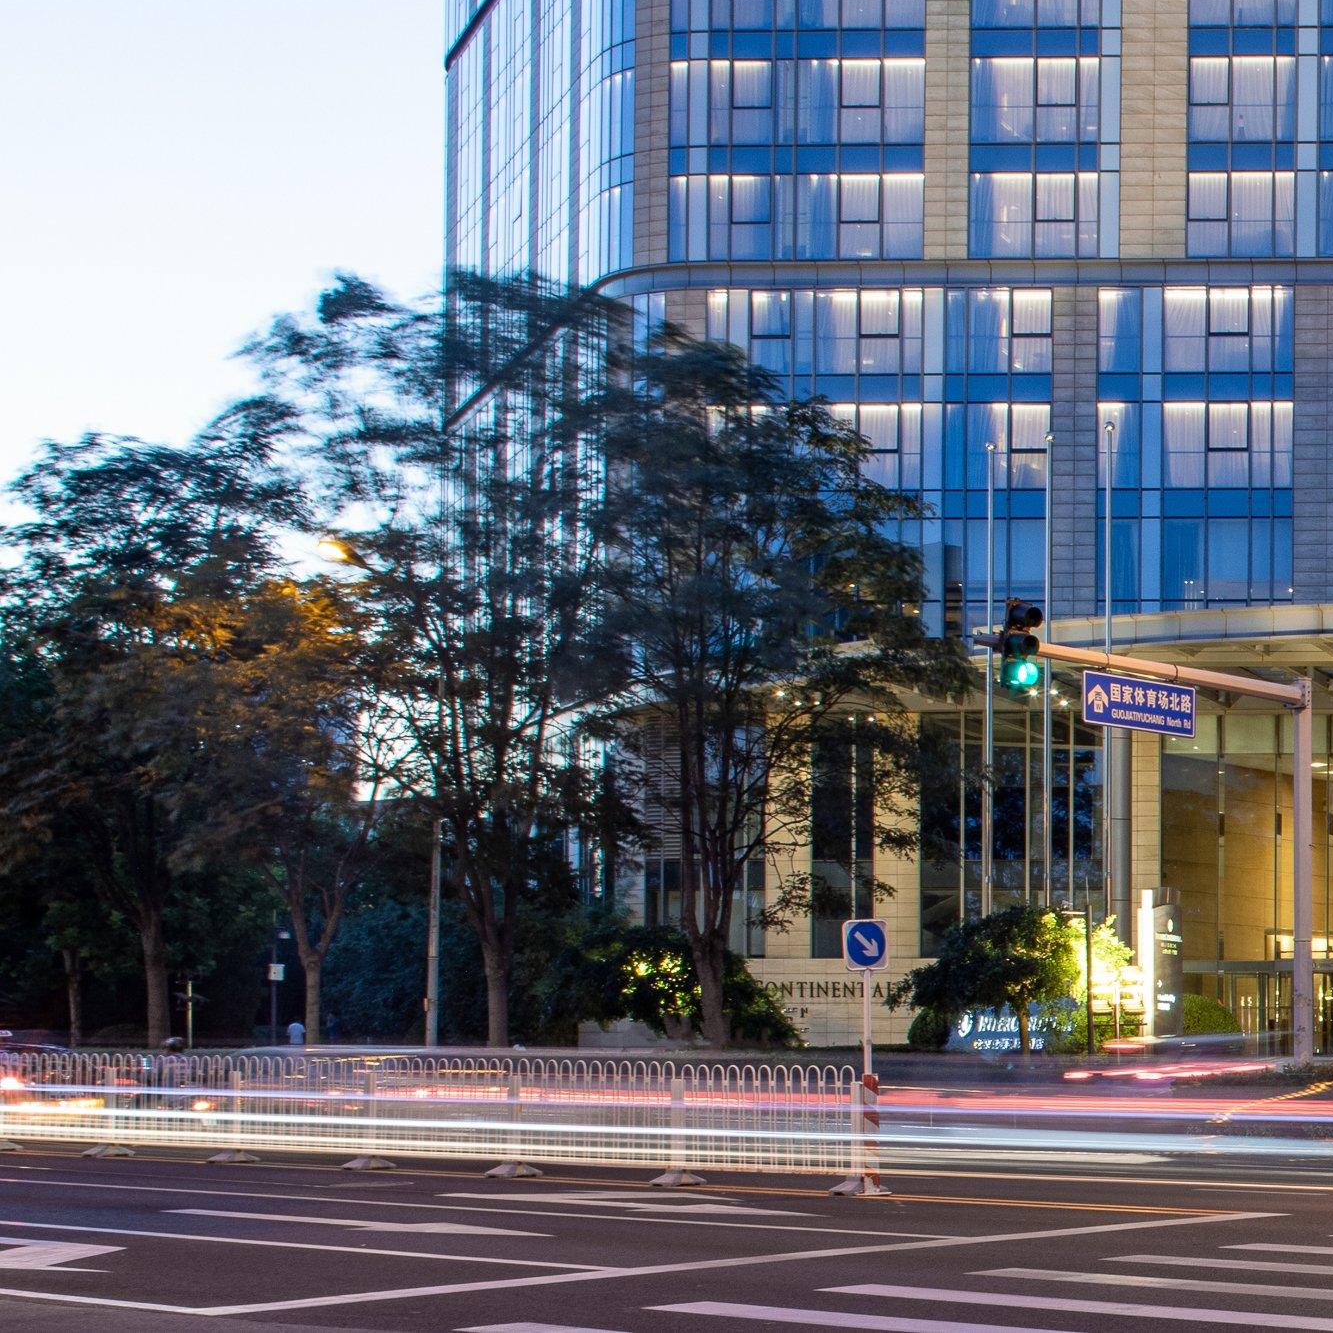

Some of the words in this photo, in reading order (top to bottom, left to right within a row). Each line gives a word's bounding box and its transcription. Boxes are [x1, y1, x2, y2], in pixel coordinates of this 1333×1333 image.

[1110, 683, 1191, 714] 国家体育场北路
[1111, 708, 1165, 726] GUOJIATIYUCHANG
[1167, 717, 1182, 728] North
[1184, 719, 1191, 729] Rd
